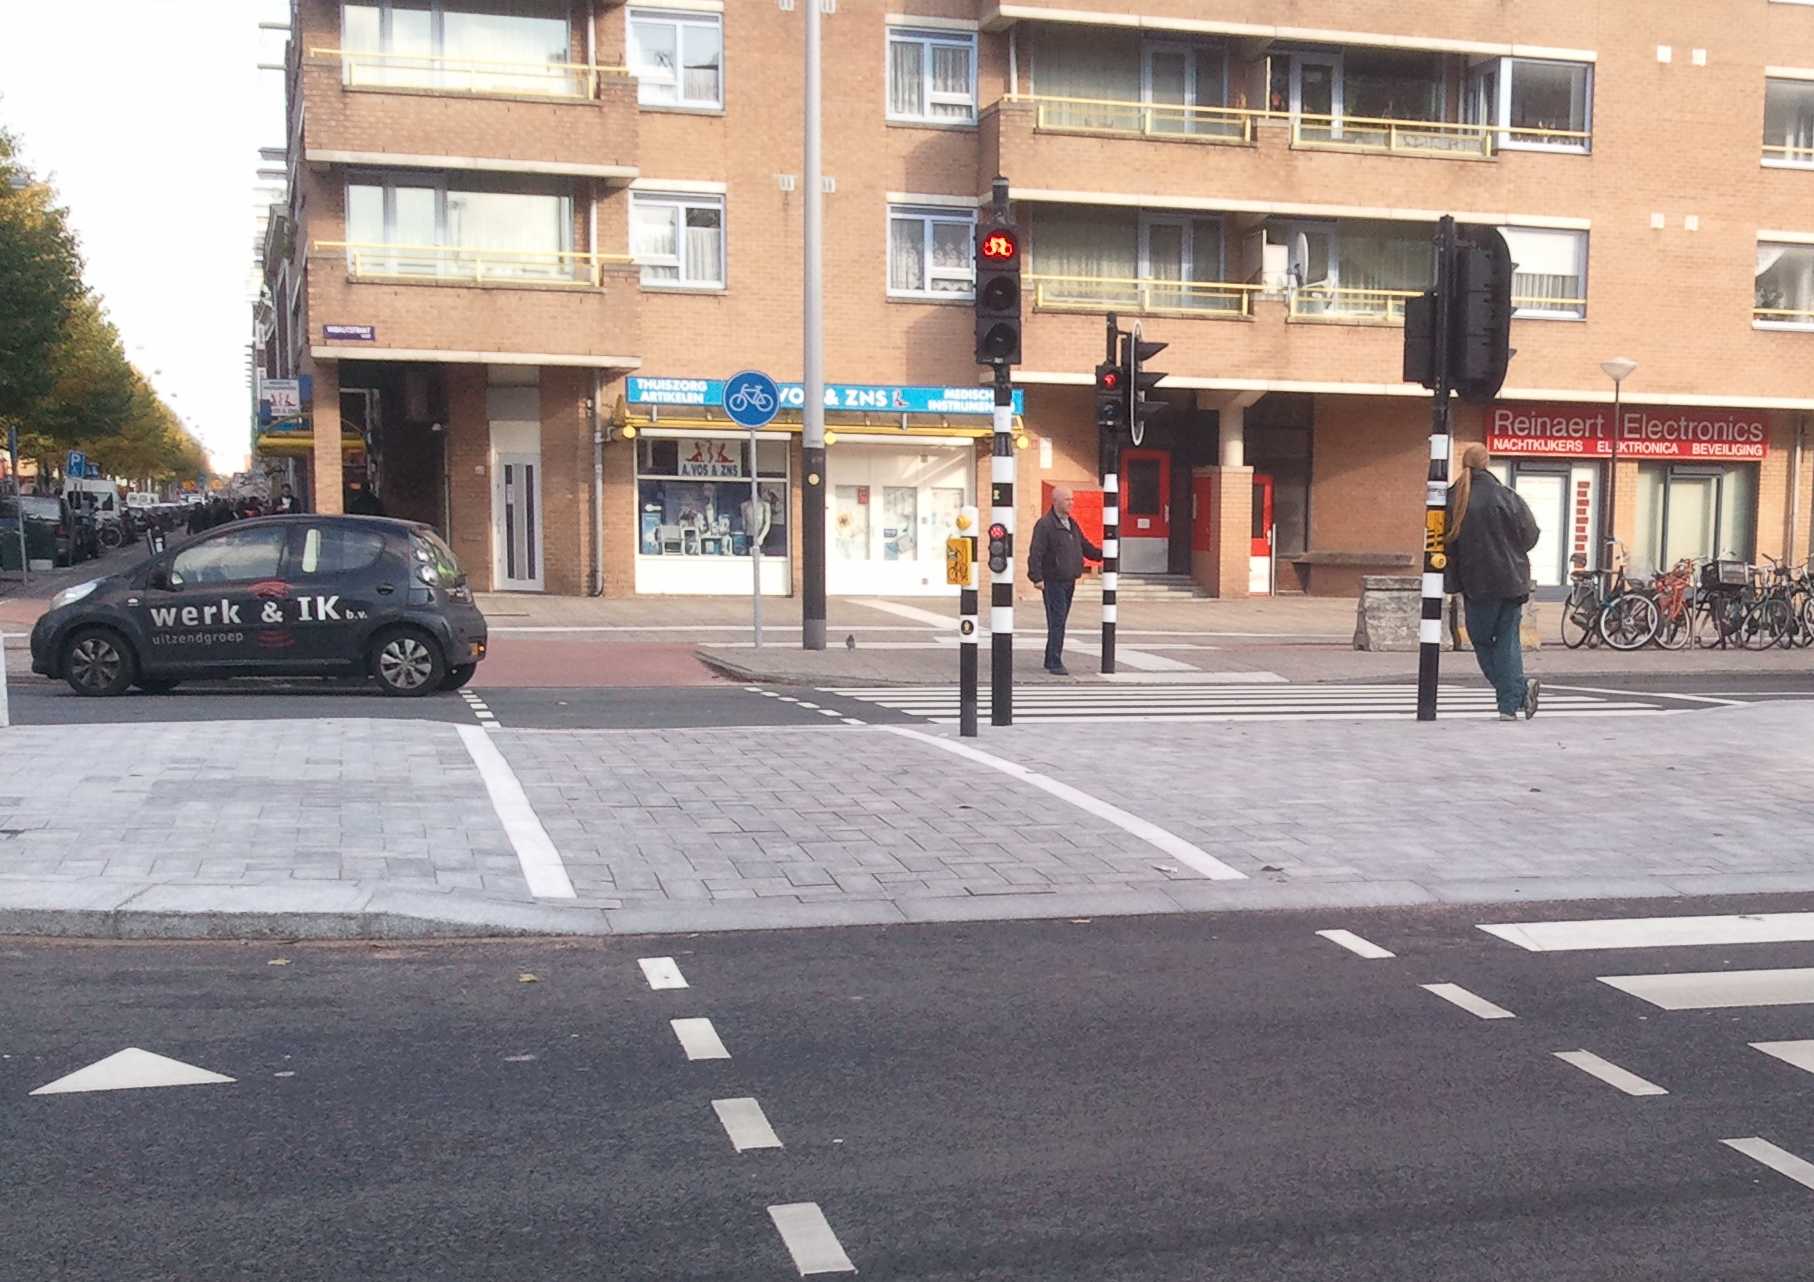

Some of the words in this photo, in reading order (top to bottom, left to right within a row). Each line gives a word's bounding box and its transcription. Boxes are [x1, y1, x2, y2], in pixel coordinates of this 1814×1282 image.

[636, 379, 707, 392] THUISZORG
[639, 392, 704, 404] ARTIKELEN
[778, 387, 805, 405] VO
[824, 388, 839, 406] &
[845, 389, 887, 407] ZNS
[943, 388, 996, 401] MEDISCH
[928, 400, 1015, 414] INSTRUMEN
[1493, 410, 1604, 438] Reinaert
[1623, 413, 1763, 442] Electronics
[1493, 438, 1583, 452] NACHTKIJKERS
[1691, 442, 1763, 456] BEVEILIGING
[150, 599, 242, 627] werk
[260, 601, 284, 623] &
[297, 595, 341, 621] IK
[345, 609, 369, 621] b.v.
[152, 631, 244, 646] uitzendgroep
